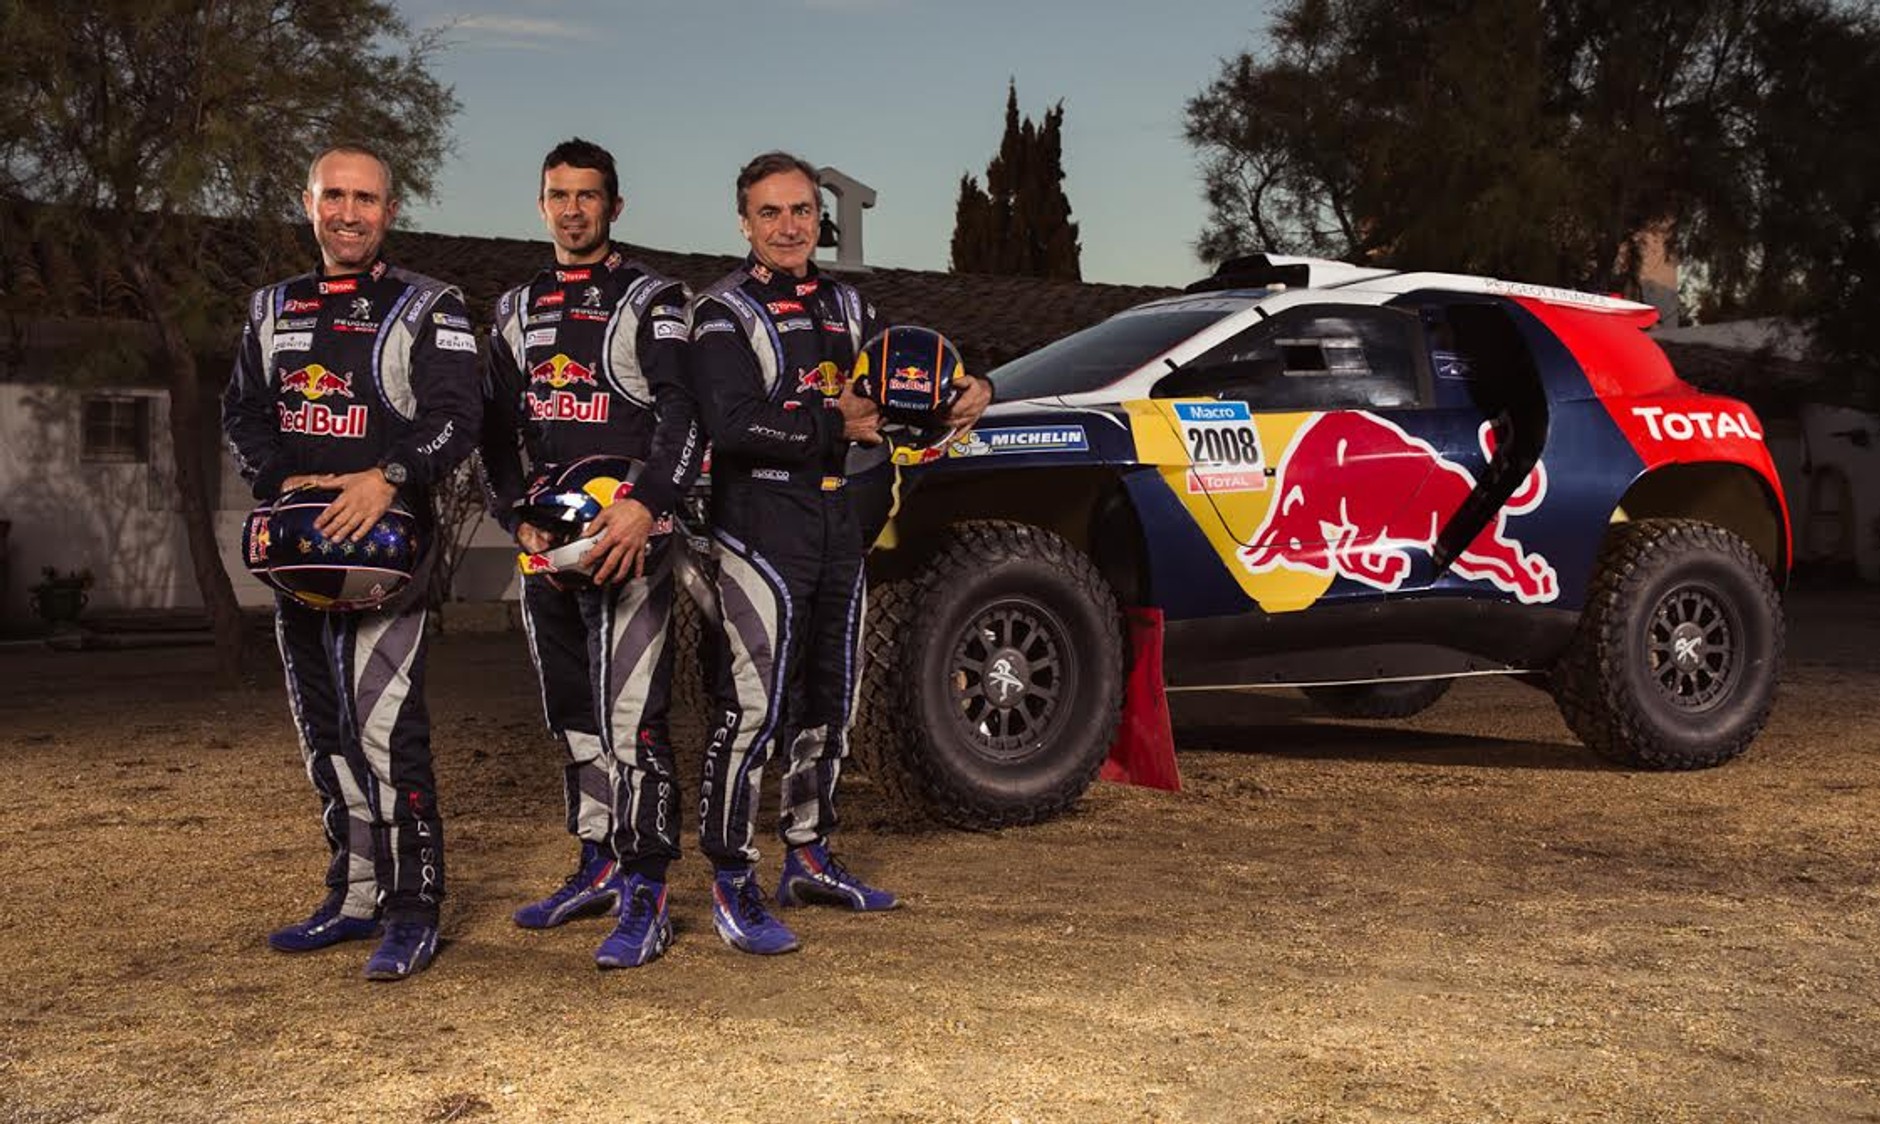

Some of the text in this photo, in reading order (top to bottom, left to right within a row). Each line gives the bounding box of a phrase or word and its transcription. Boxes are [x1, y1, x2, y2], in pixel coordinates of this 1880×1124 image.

[333, 318, 379, 328] PEUGEOT
[526, 390, 610, 422] Red Bull
[889, 399, 929, 410] PEUGEOT
[1189, 406, 1235, 419] Macro
[277, 401, 368, 438] Red Bull
[991, 431, 1082, 446] MICHELIN
[1188, 427, 1258, 466] 2008
[700, 709, 738, 838] PEUGEOT
